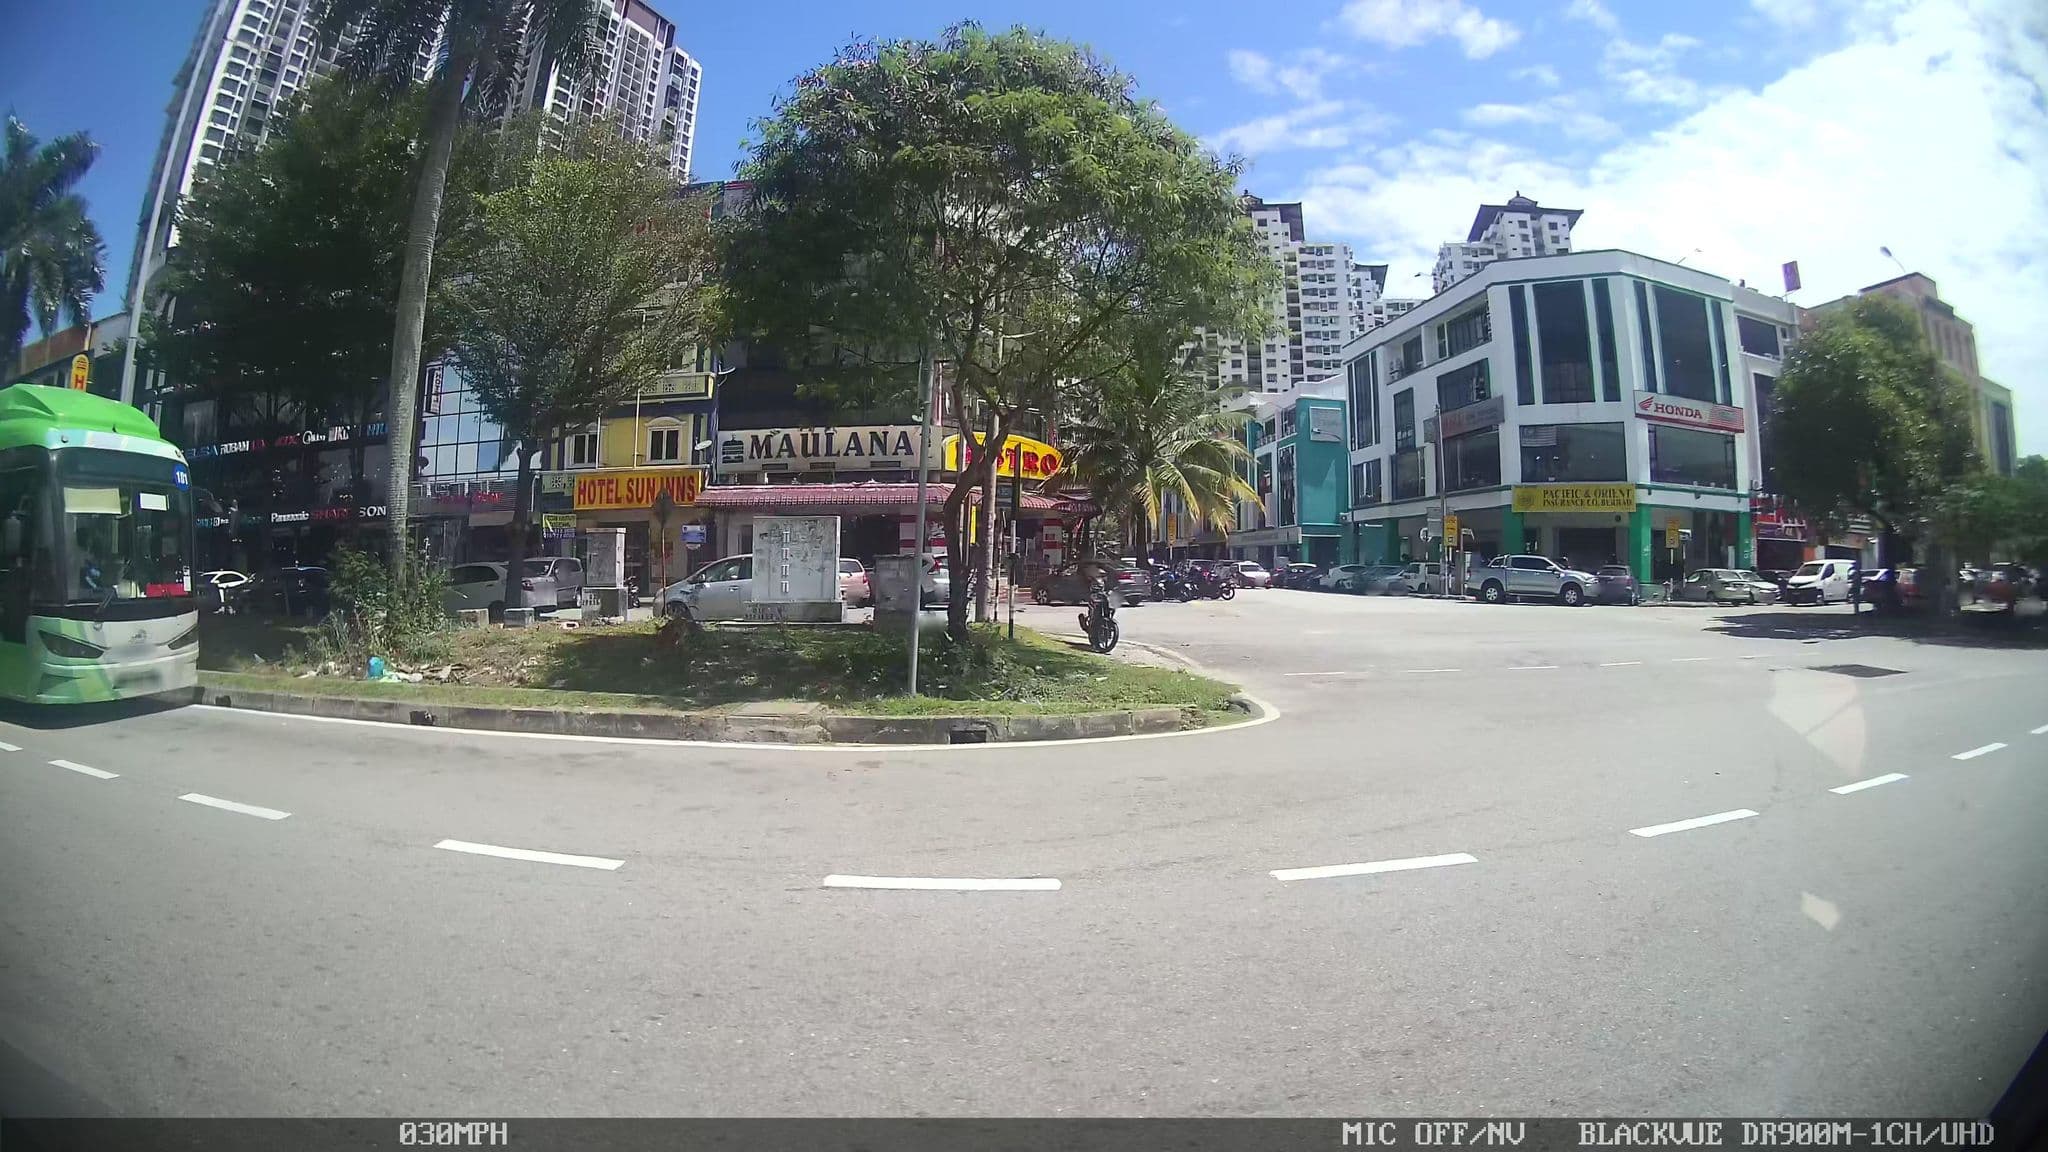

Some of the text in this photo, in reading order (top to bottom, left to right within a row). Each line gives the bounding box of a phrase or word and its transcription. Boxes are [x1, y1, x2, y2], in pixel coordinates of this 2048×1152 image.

[1653, 403, 1703, 419] HONDA
[748, 430, 915, 459] MAULANA
[577, 475, 695, 505] HOTEL SUN INNS
[1543, 489, 1582, 499] PACIFIC
[1594, 488, 1632, 499] ORIENT
[1543, 499, 1584, 507] INSURANCE
